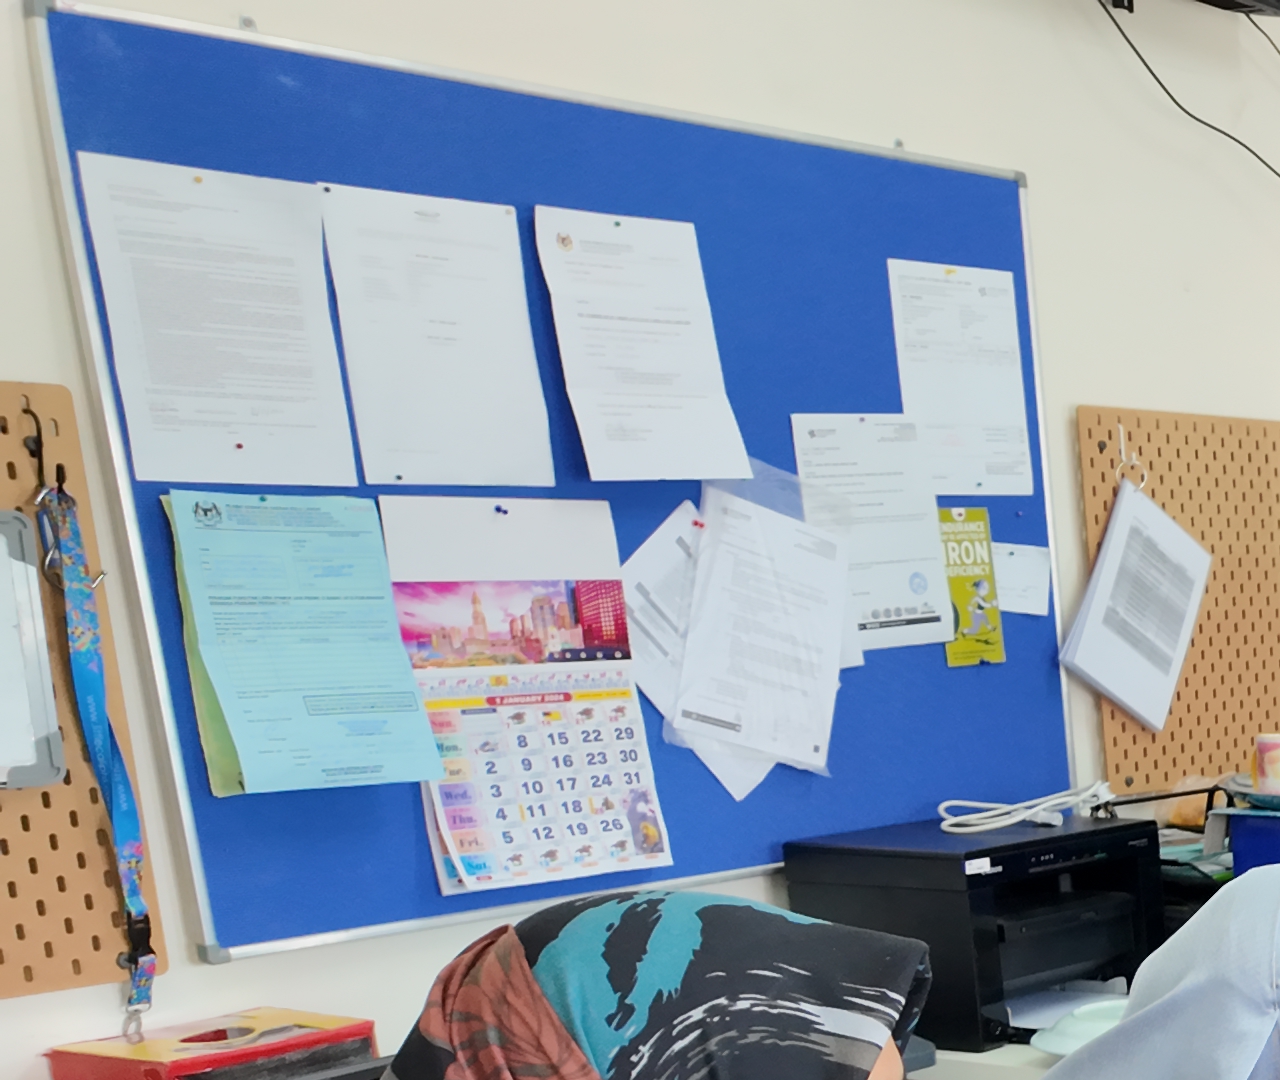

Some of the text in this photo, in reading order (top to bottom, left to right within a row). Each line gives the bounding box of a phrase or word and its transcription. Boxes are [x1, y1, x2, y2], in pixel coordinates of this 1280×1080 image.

[501, 694, 542, 705] JANUARY
[517, 734, 529, 748] 8
[547, 732, 569, 746] 15
[581, 729, 604, 743] 22
[614, 727, 635, 740] 29
[485, 761, 497, 775] 2
[521, 758, 532, 771] 9
[552, 754, 574, 769] 16
[586, 752, 608, 766] 23
[619, 749, 638, 763] 30
[490, 784, 502, 798] 3
[522, 781, 543, 794] 10
[556, 777, 577, 792] 17
[590, 774, 613, 788] 24
[624, 772, 641, 785] 31
[495, 808, 508, 821] 4
[527, 804, 546, 817] 11
[561, 800, 583, 814] 18
[502, 831, 514, 844] 5
[532, 826, 554, 840] 12
[567, 823, 588, 836] 19
[600, 818, 623, 832] 26
